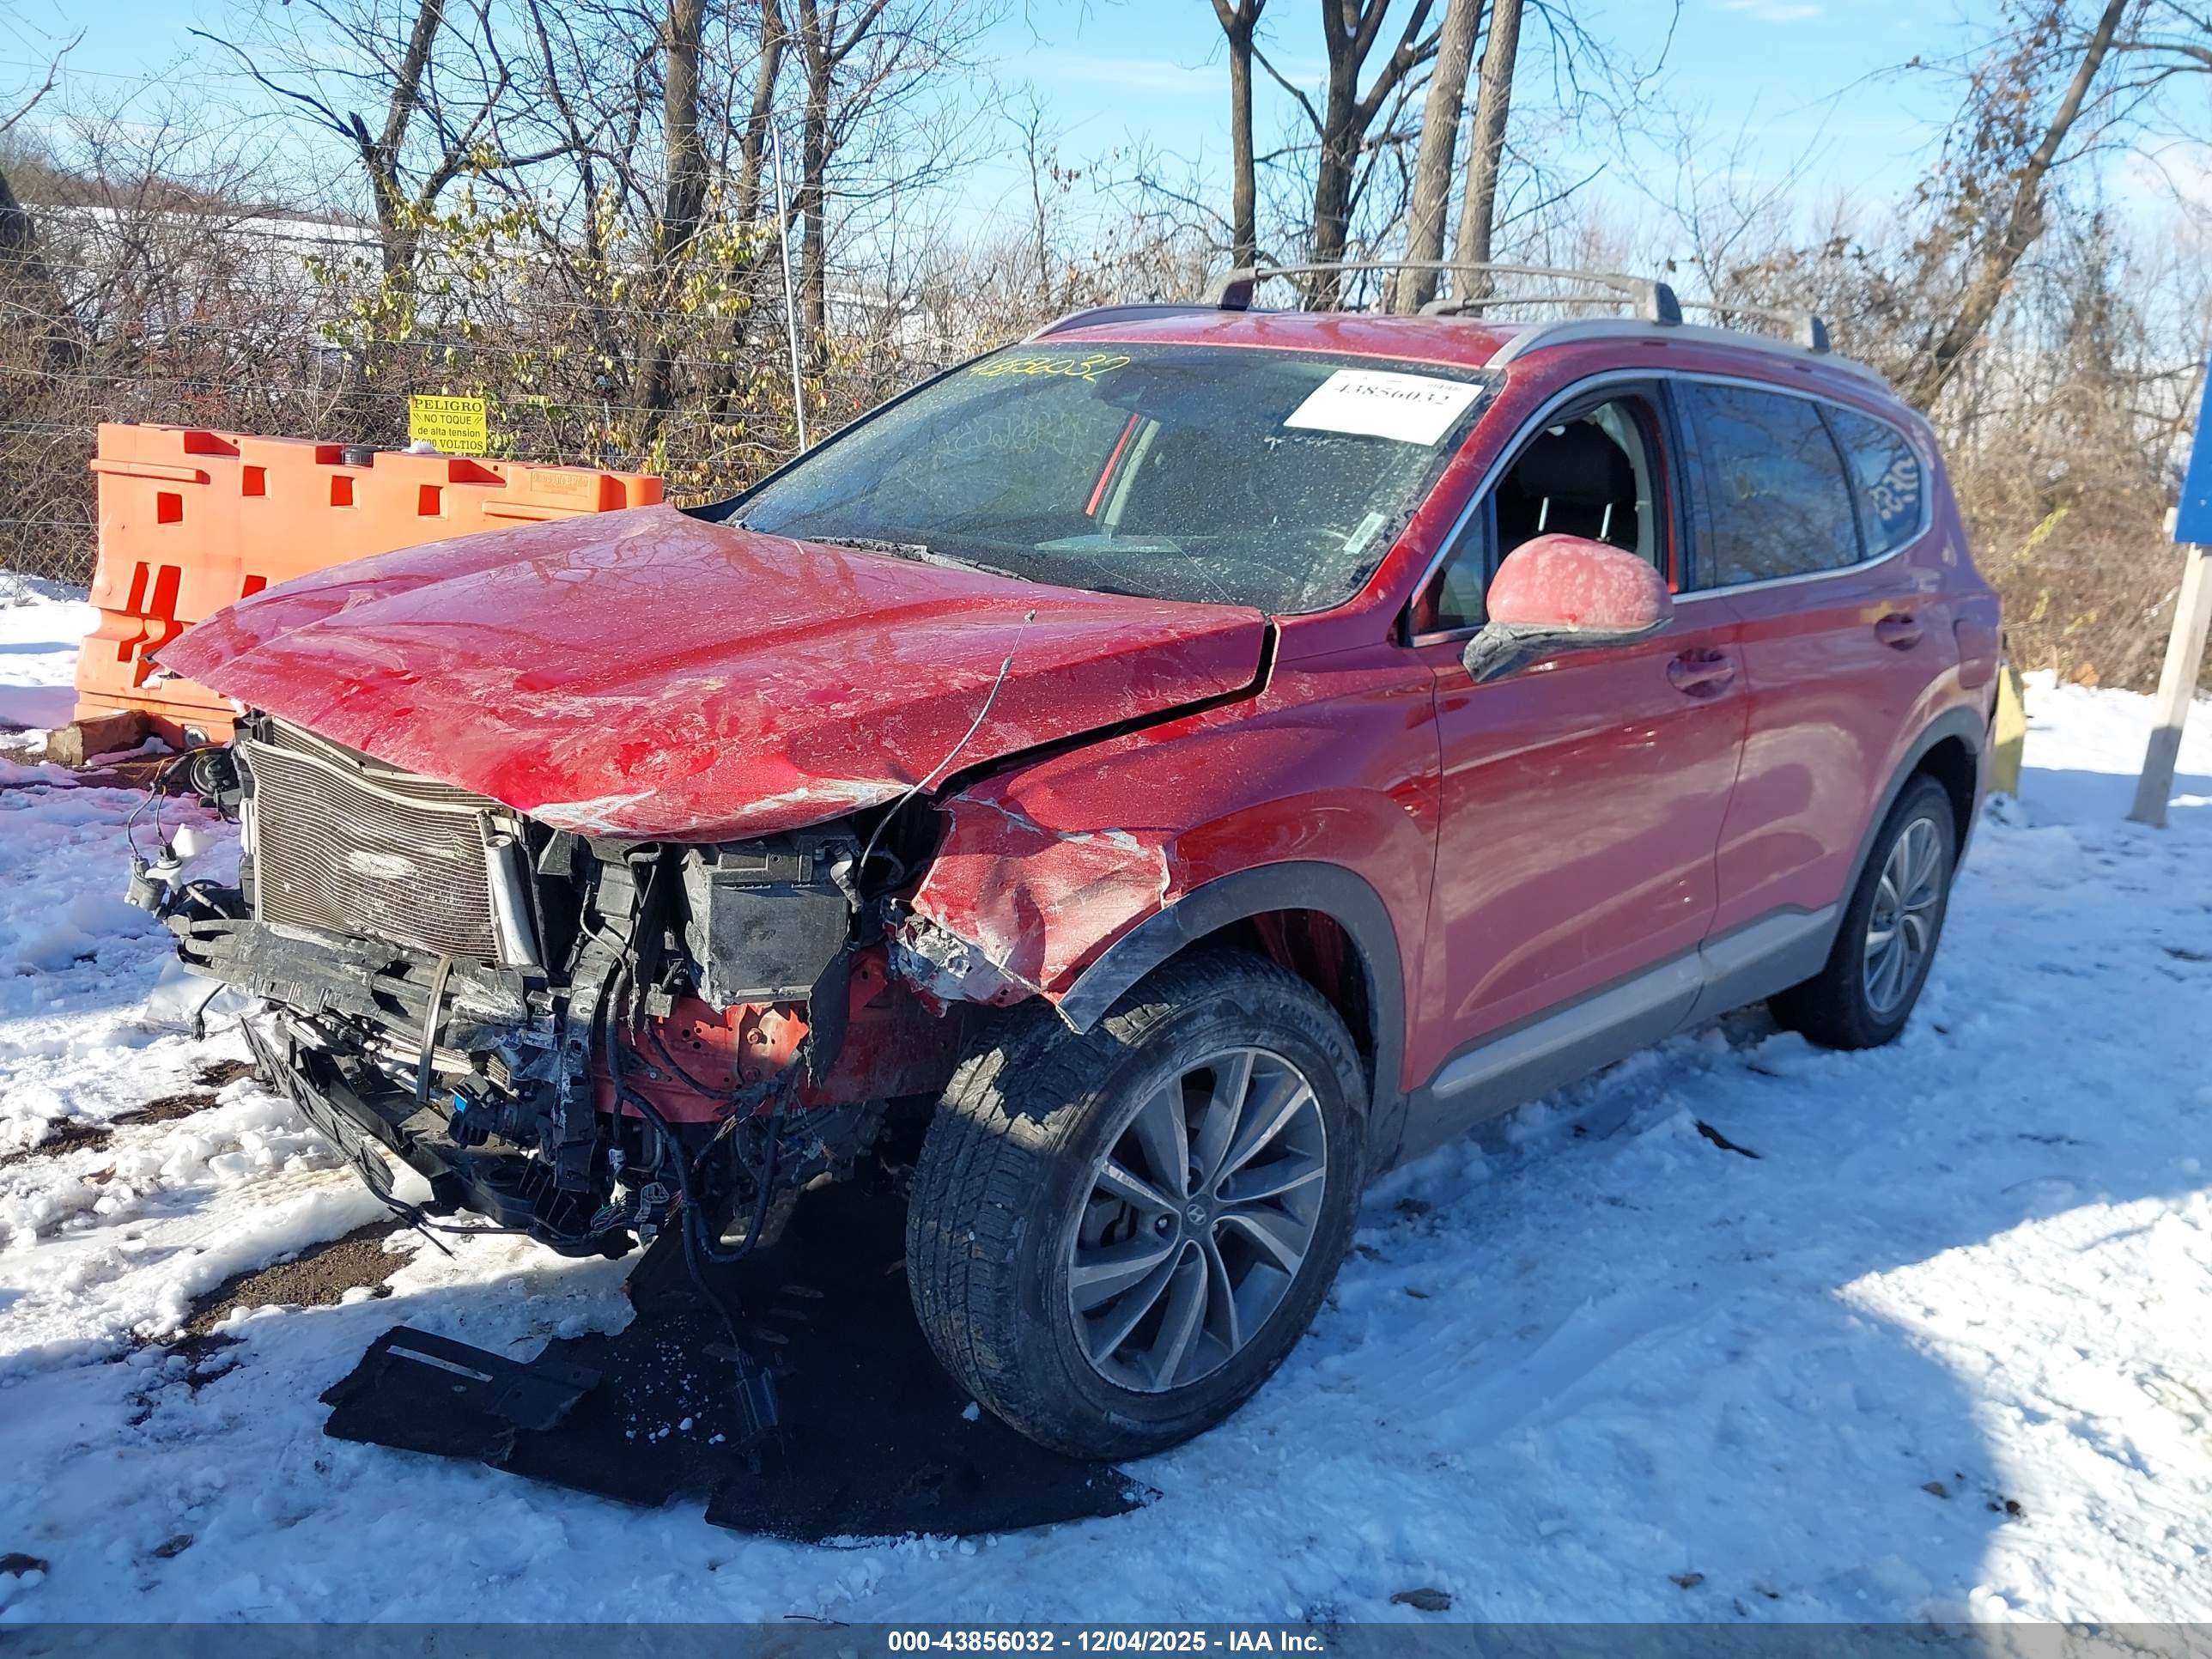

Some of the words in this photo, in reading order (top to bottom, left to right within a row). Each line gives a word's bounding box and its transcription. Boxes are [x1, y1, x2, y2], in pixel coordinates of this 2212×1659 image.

[1334, 383, 1450, 405] 43856032
[414, 398, 483, 412] PELIGRO
[423, 414, 438, 423] NO
[440, 415, 472, 425] TOQUE
[417, 426, 428, 434] de
[431, 427, 447, 436] alta
[448, 428, 481, 437] tension
[440, 440, 483, 451] VOLTIOS
